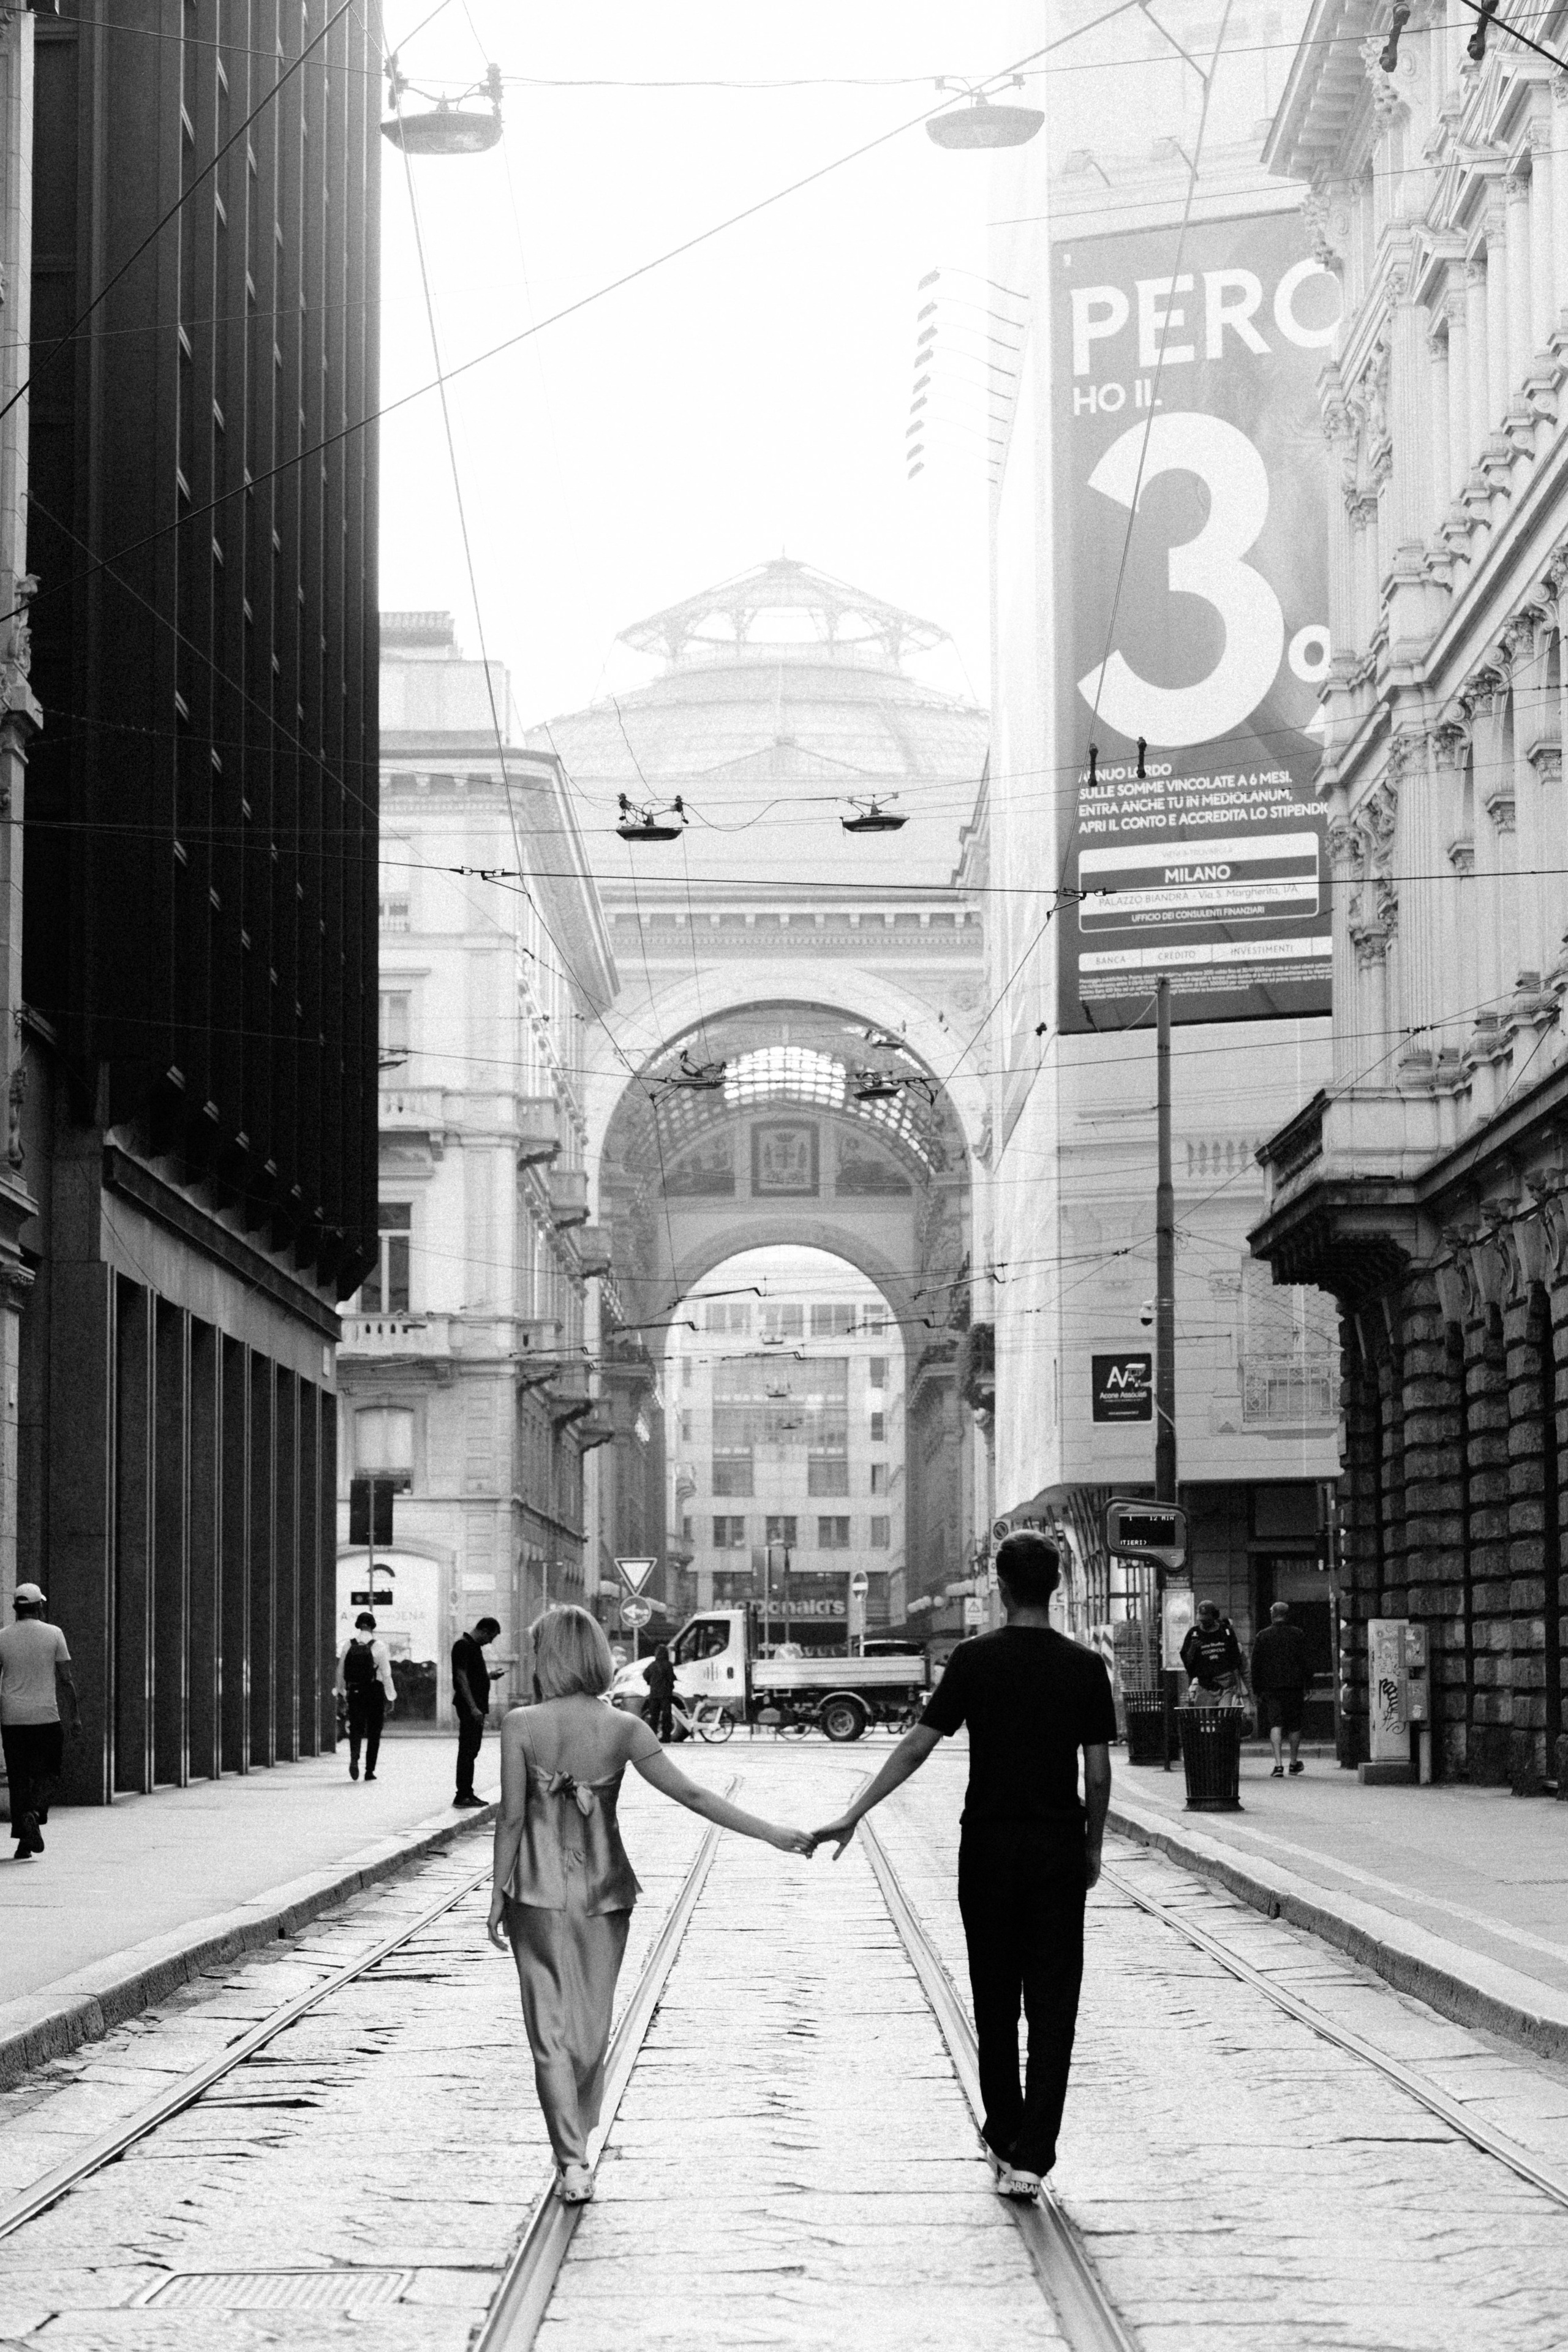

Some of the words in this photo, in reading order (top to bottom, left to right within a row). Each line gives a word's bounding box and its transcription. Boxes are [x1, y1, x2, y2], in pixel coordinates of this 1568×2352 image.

[1074, 382, 1126, 416] HO
[1079, 785, 1115, 800] SULLE
[1117, 781, 1164, 797] SOMME
[1166, 774, 1235, 792] VINCOLATE
[1238, 775, 1247, 787] A
[1250, 774, 1257, 786] 6
[1259, 771, 1292, 785] MESI.
[1079, 804, 1119, 817] ENTRA
[1121, 799, 1165, 813] ANCHE
[1167, 796, 1183, 809] TU
[1186, 794, 1199, 808] IN
[1201, 790, 1293, 807] MEDIOLANUM,
[1079, 819, 1106, 834] APRI
[1109, 818, 1119, 831] IL
[1121, 815, 1166, 830] CONTO
[1169, 814, 1177, 826] E
[1178, 809, 1248, 825] ACCREDITA
[1250, 807, 1268, 820] LO
[1164, 864, 1231, 883] MILANO
[1099, 895, 1142, 907] PALAZZO
[1198, 889, 1213, 899] Via
[1131, 912, 1161, 922] UFFICIO
[1162, 910, 1175, 920] DEI
[1175, 906, 1223, 919] CONSULENTI
[1223, 905, 1265, 916] FINANZIARI
[1095, 955, 1126, 965] BANCA
[1158, 949, 1196, 961] CREDITO
[1230, 944, 1294, 956] INVESTIMENTI
